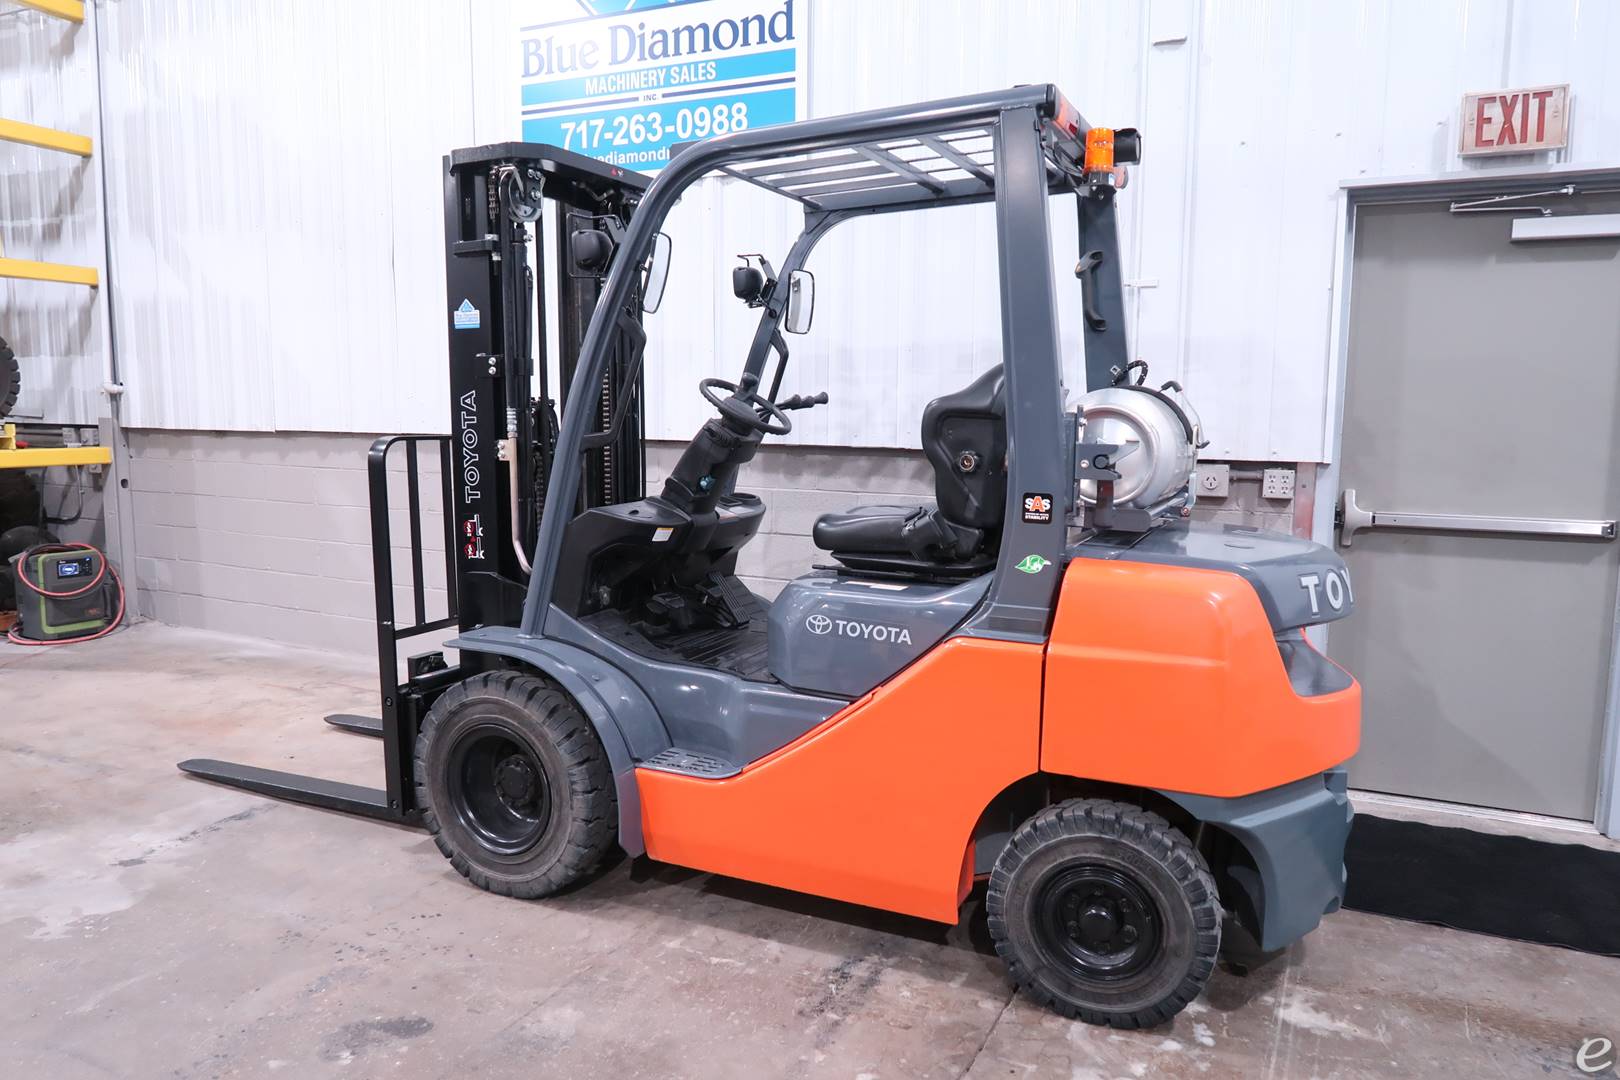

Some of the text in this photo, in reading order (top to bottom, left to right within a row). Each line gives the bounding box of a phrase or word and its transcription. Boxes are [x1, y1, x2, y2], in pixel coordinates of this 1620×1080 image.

[521, 0, 796, 78] Blue Diamond
[585, 61, 717, 97] MACHINERY SALES
[560, 102, 749, 151] 717-263-0988
[1475, 91, 1554, 147] EXIT
[460, 390, 481, 503] TOYOTA
[1024, 496, 1051, 512] SAS
[835, 620, 912, 645] TOYOTA
